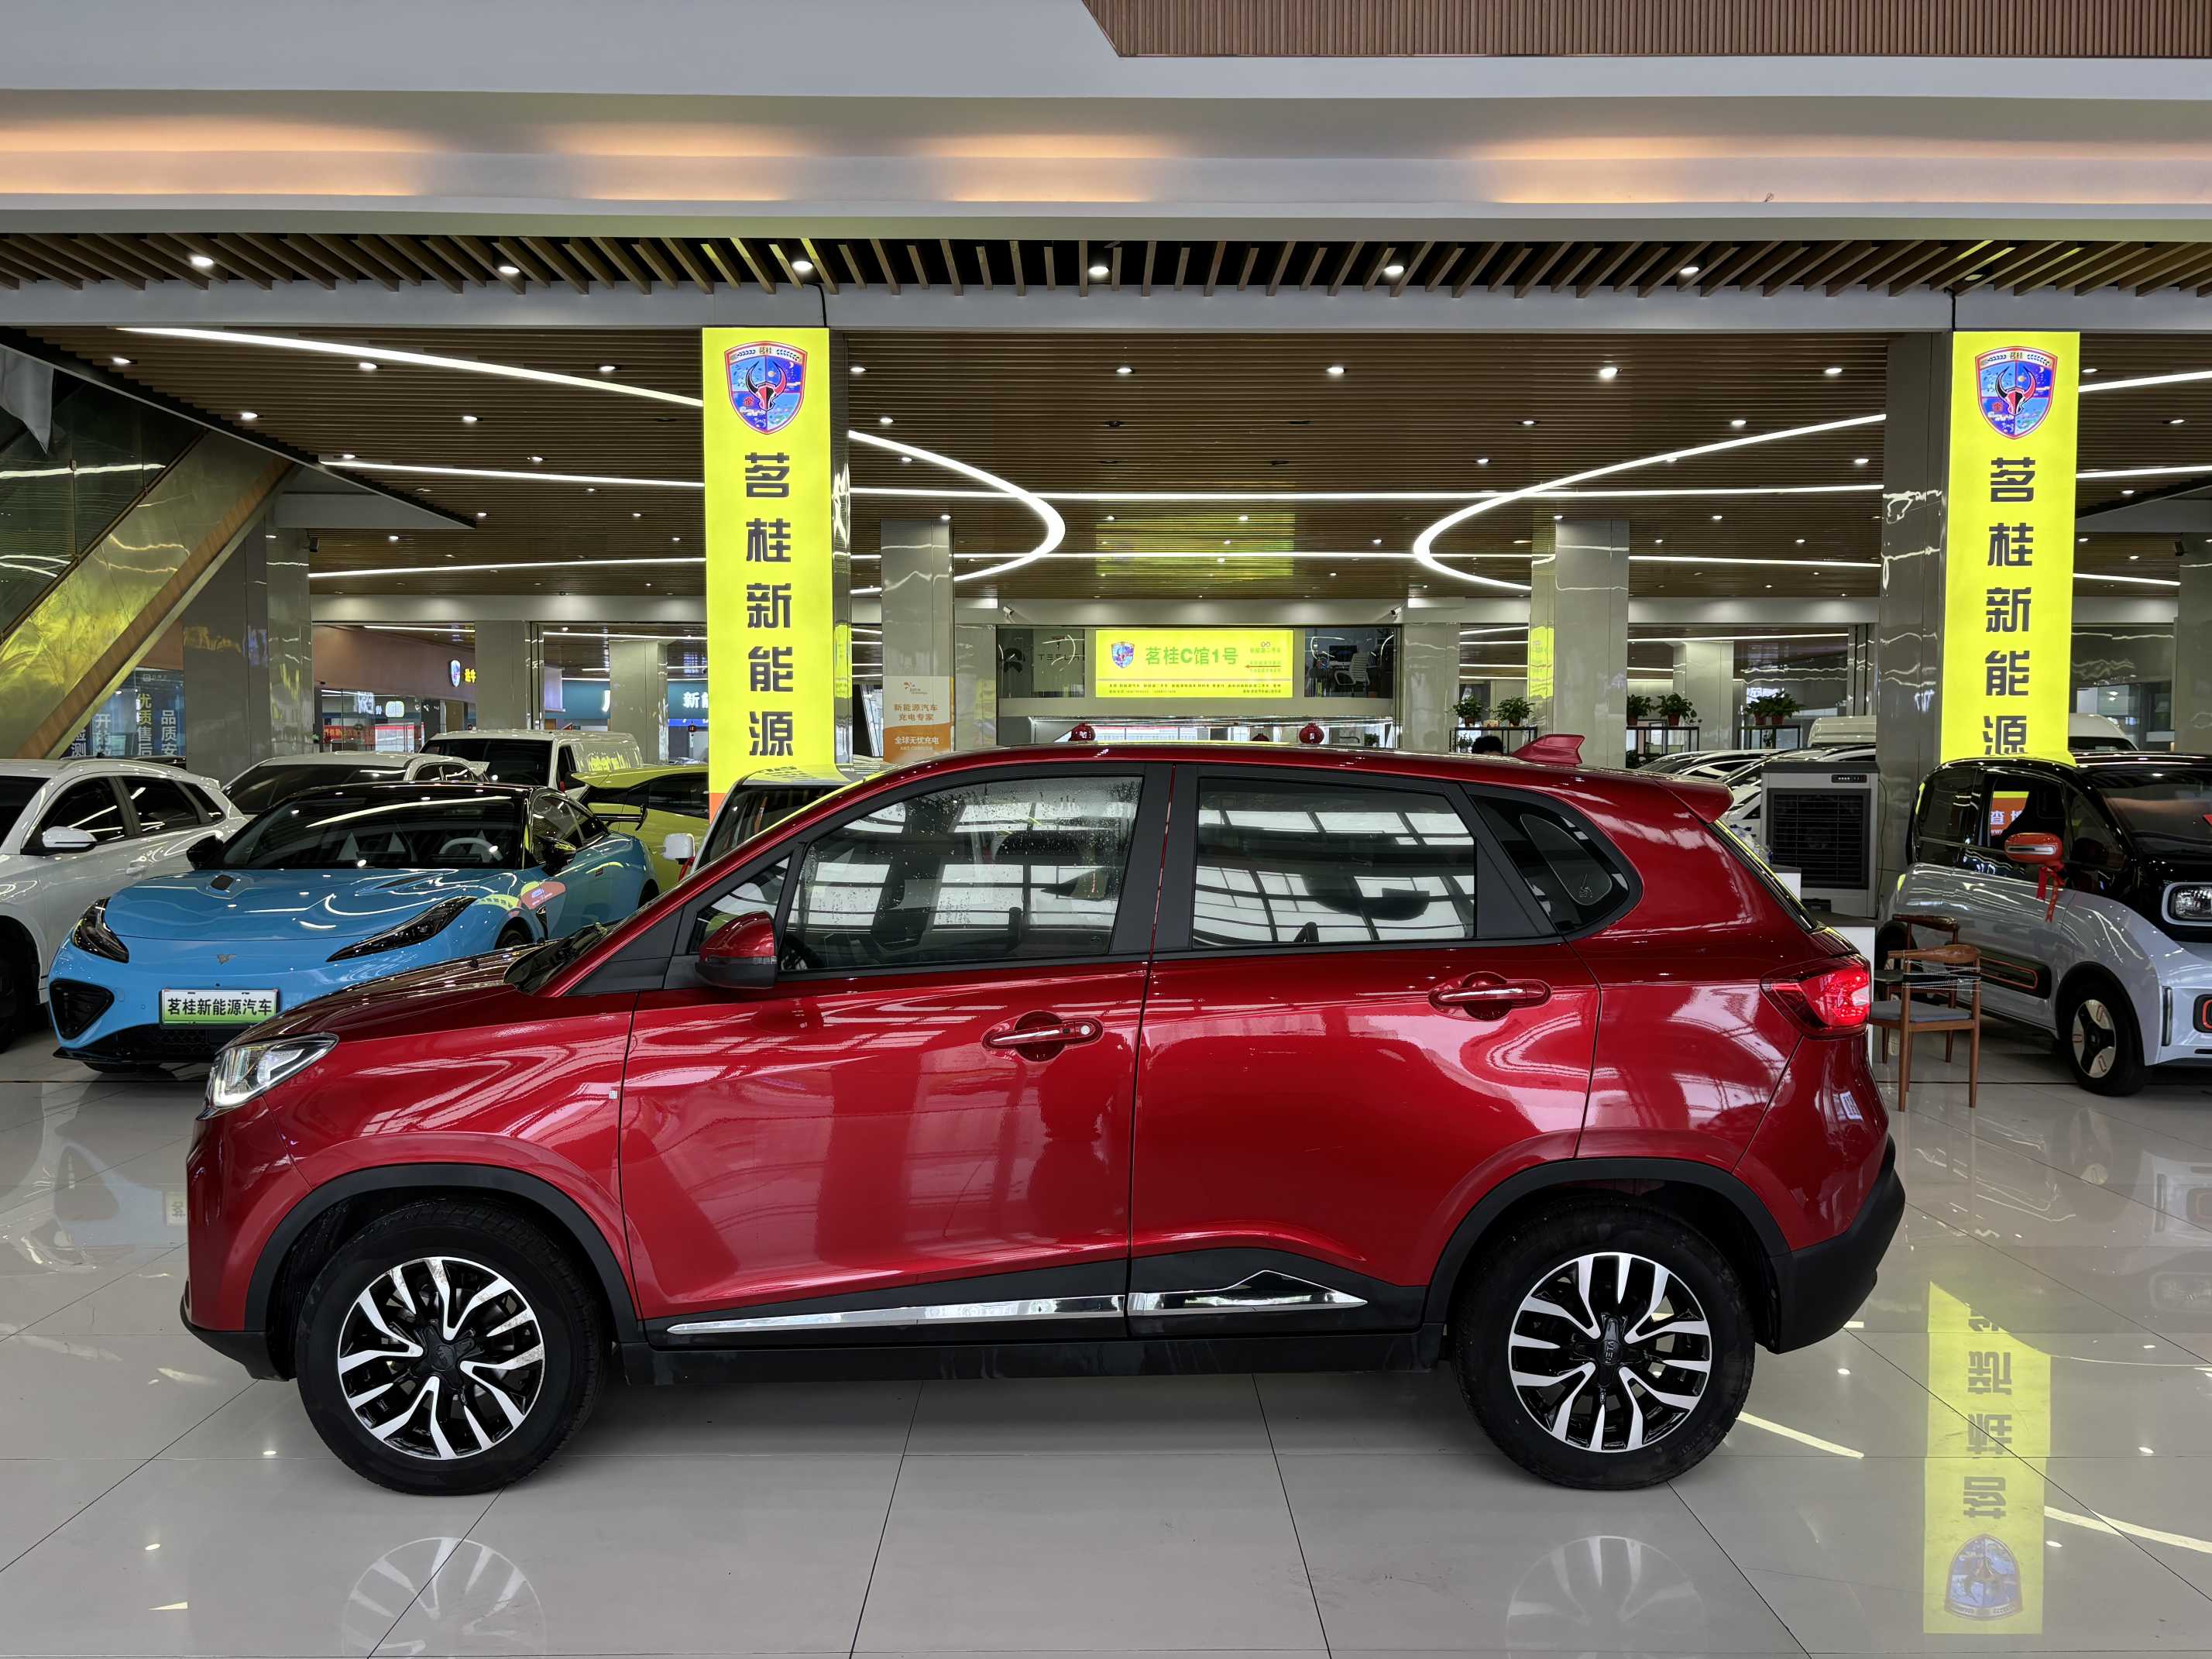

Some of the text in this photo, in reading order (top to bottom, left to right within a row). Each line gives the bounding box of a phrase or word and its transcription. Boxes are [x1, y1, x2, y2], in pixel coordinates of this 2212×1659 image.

[744, 452, 794, 757] 茗桂新能源
[1982, 456, 2036, 755] 茗桂新能源
[1146, 646, 1239, 665] 茗桂C馆1号
[137, 693, 153, 757] 优质售后
[894, 703, 939, 712] 新能源汽车
[167, 998, 273, 1016] 茗桂新能源汽车
